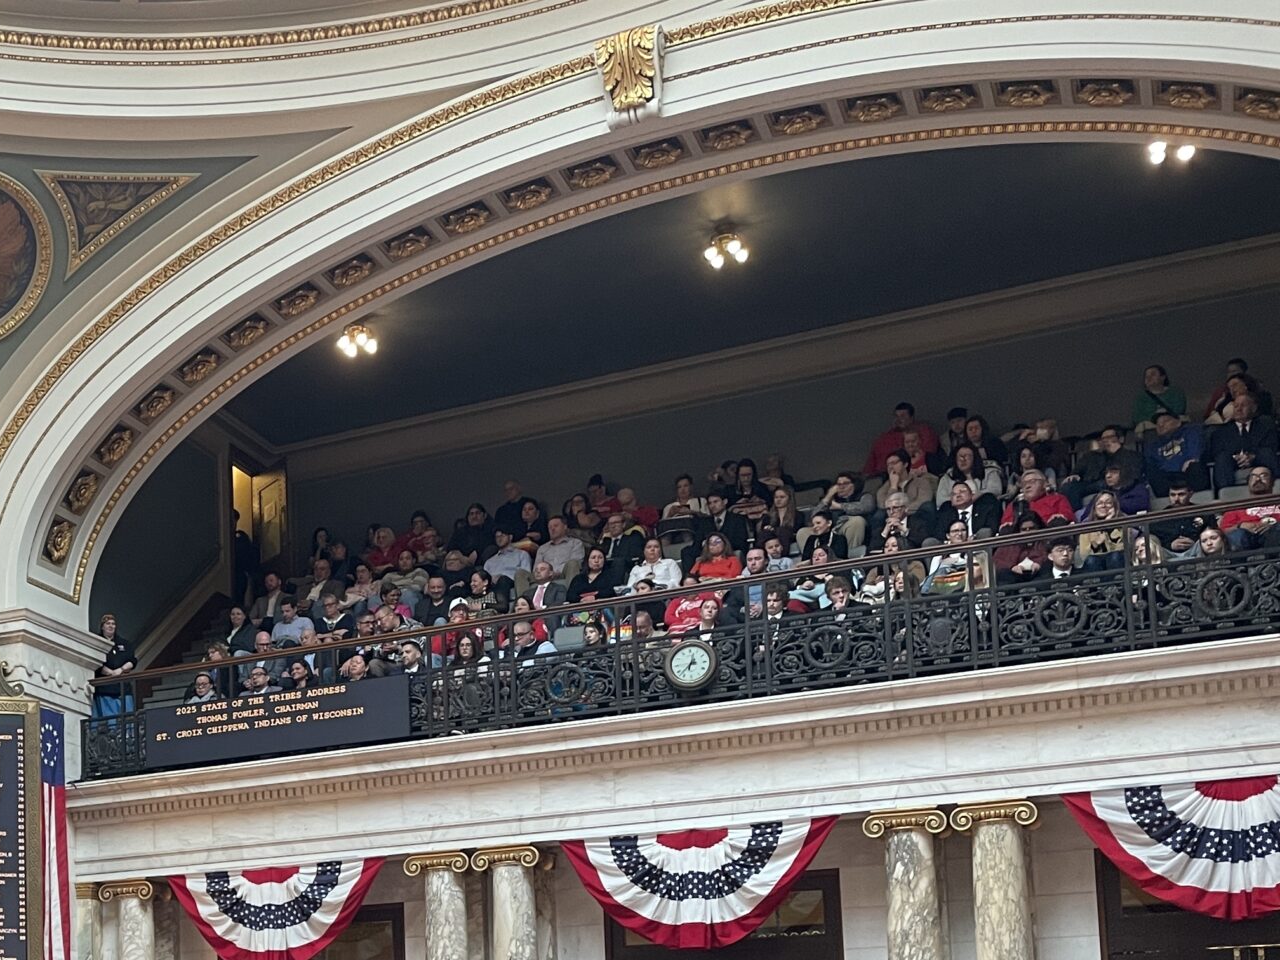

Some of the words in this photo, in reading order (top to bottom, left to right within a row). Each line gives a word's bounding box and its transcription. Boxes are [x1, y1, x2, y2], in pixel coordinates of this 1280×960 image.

[175, 705, 197, 715] 2025
[201, 701, 228, 712] STATE
[231, 699, 244, 708] OF
[248, 696, 264, 706] THE
[269, 691, 302, 703] TRIBES
[306, 685, 346, 697] ADDRESS
[196, 713, 228, 725] THOMAS
[232, 708, 269, 720] FOWLER,
[274, 701, 319, 714] CHAIRMAN
[155, 732, 171, 741] ST.
[175, 728, 203, 739] CROIX
[206, 722, 249, 735] CHIPPEWA
[254, 716, 292, 729] INDIANS
[296, 714, 308, 723] OF
[312, 706, 364, 721] WISCONSIN
